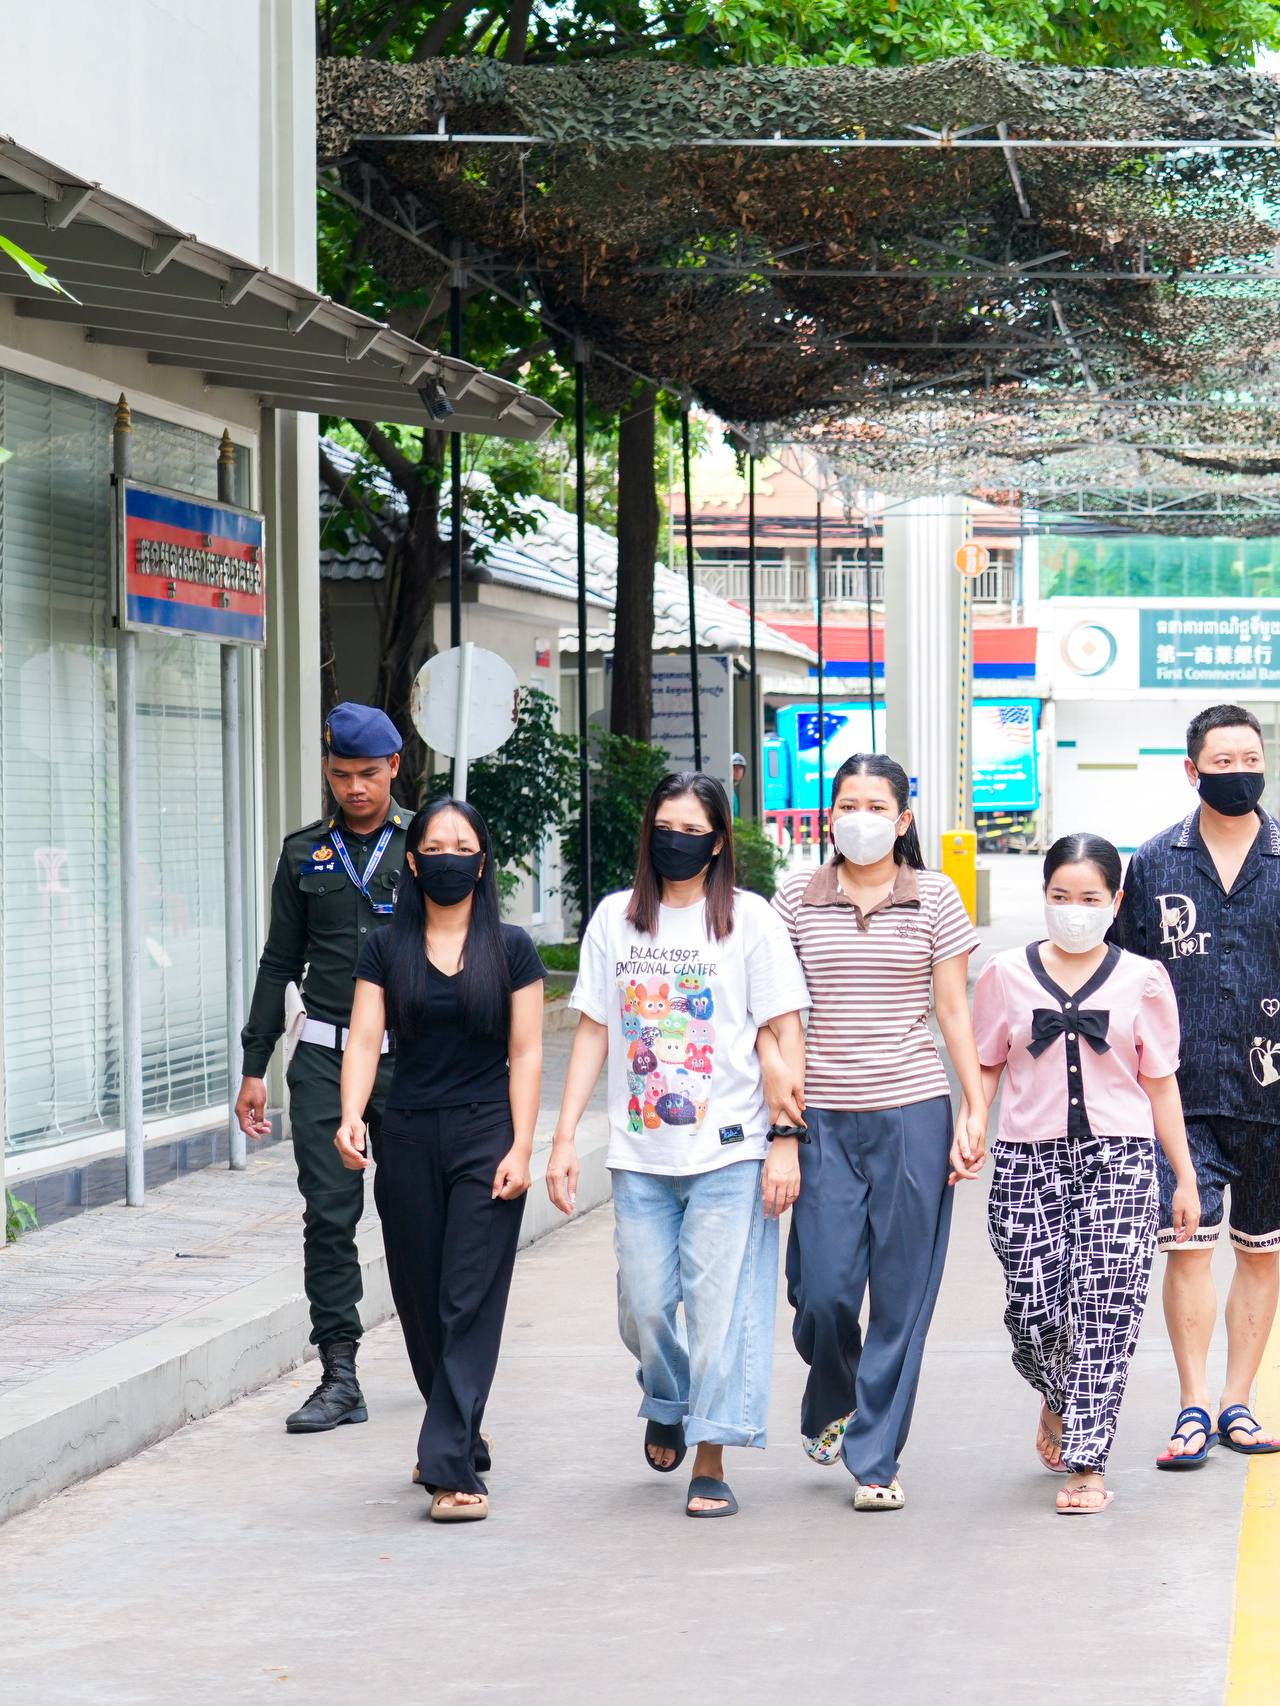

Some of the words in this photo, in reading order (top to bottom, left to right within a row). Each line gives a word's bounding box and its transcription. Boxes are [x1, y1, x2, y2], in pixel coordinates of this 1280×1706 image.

[1156, 645, 1272, 664] 第一商業銀行
[1156, 667, 1182, 680] First
[1184, 667, 1257, 680] Commercial
[615, 961, 670, 977] EMOTIONAL
[673, 963, 718, 976] CENTER
